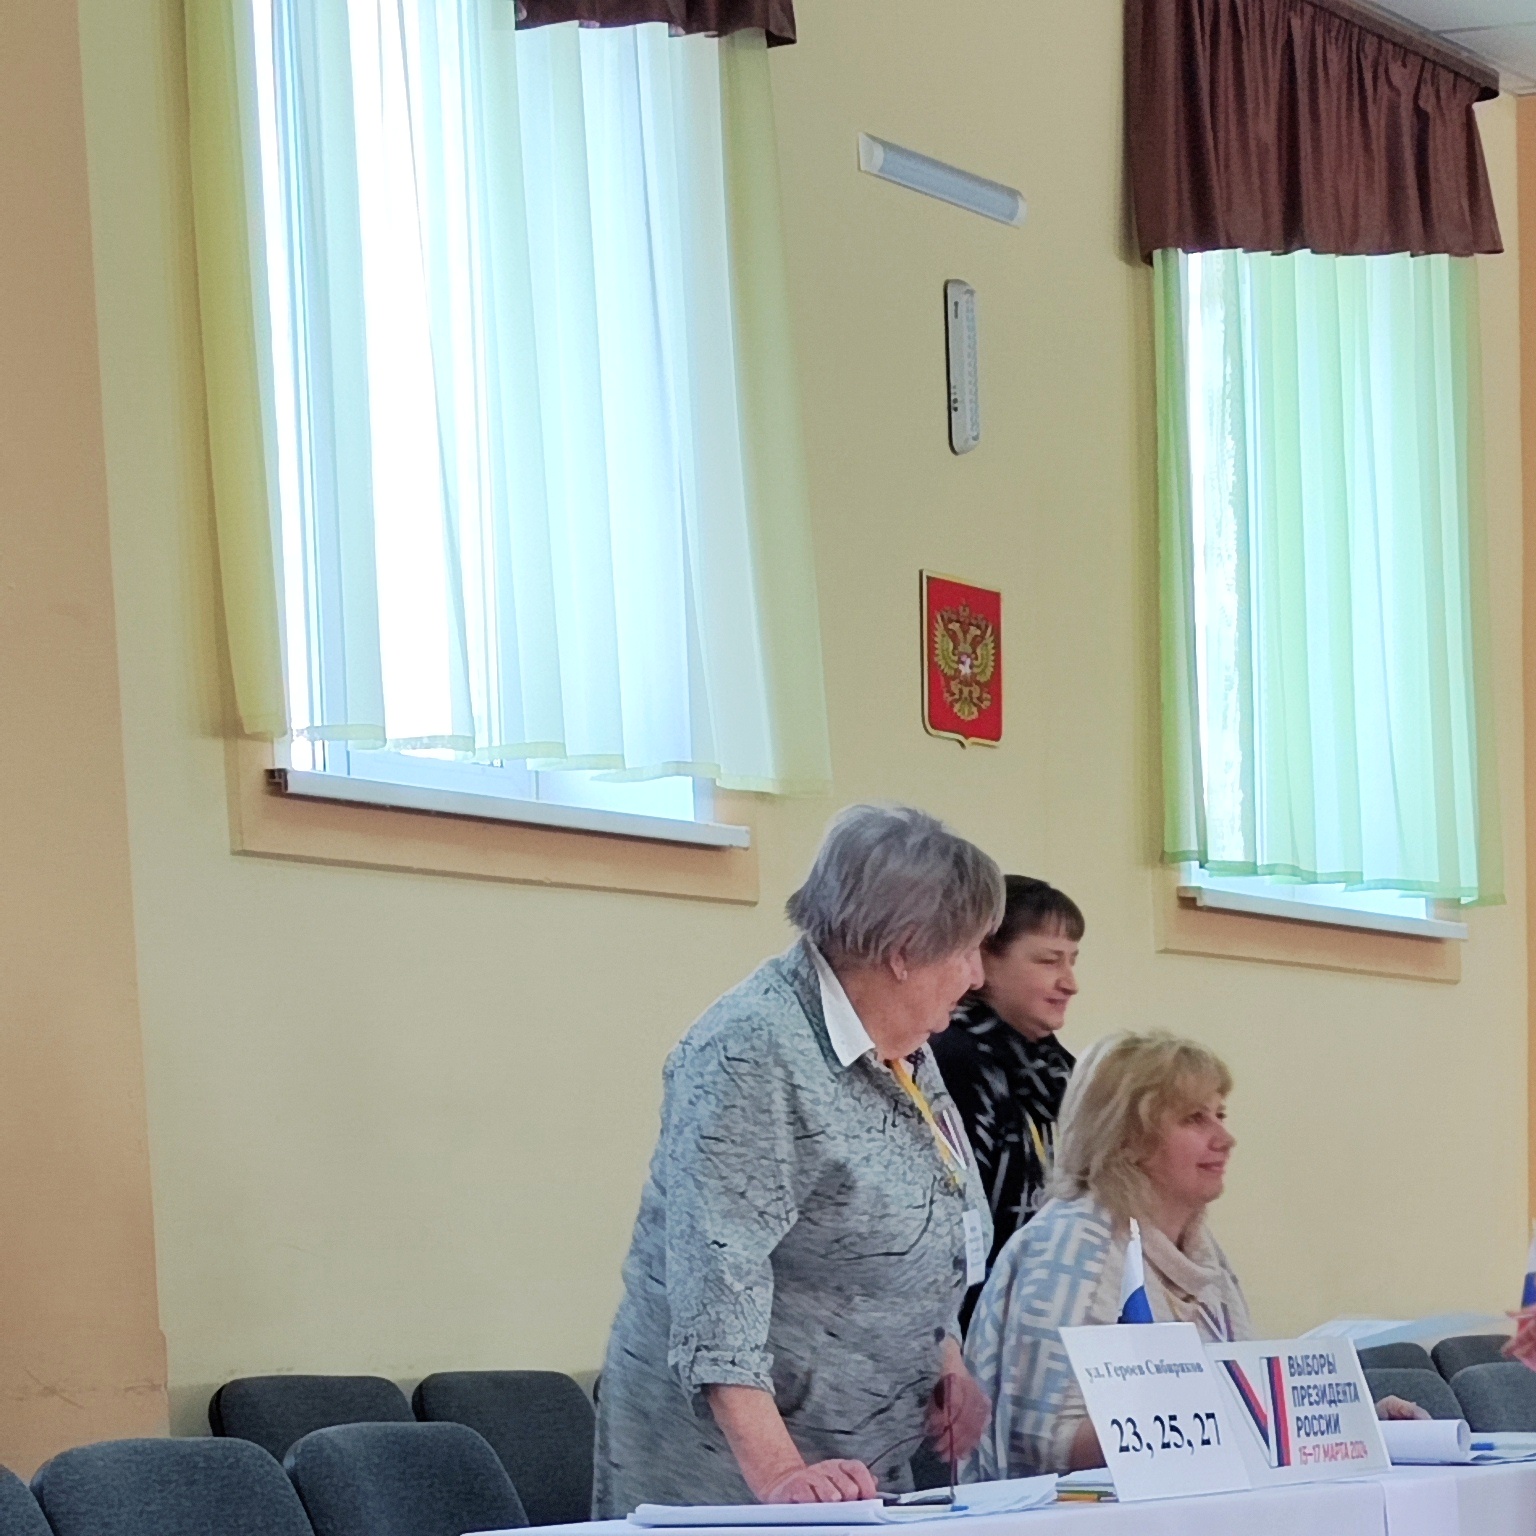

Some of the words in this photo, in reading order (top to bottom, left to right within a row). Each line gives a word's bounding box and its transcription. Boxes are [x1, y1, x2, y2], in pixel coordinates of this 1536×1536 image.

[1104, 1361, 1145, 1381] Героев
[1288, 1353, 1338, 1378] ВЫБОРЫ
[1292, 1382, 1361, 1408] ПРЕЗИДЕНТА
[1296, 1413, 1342, 1438] РОССИИ
[1322, 1441, 1350, 1462] МАРТА
